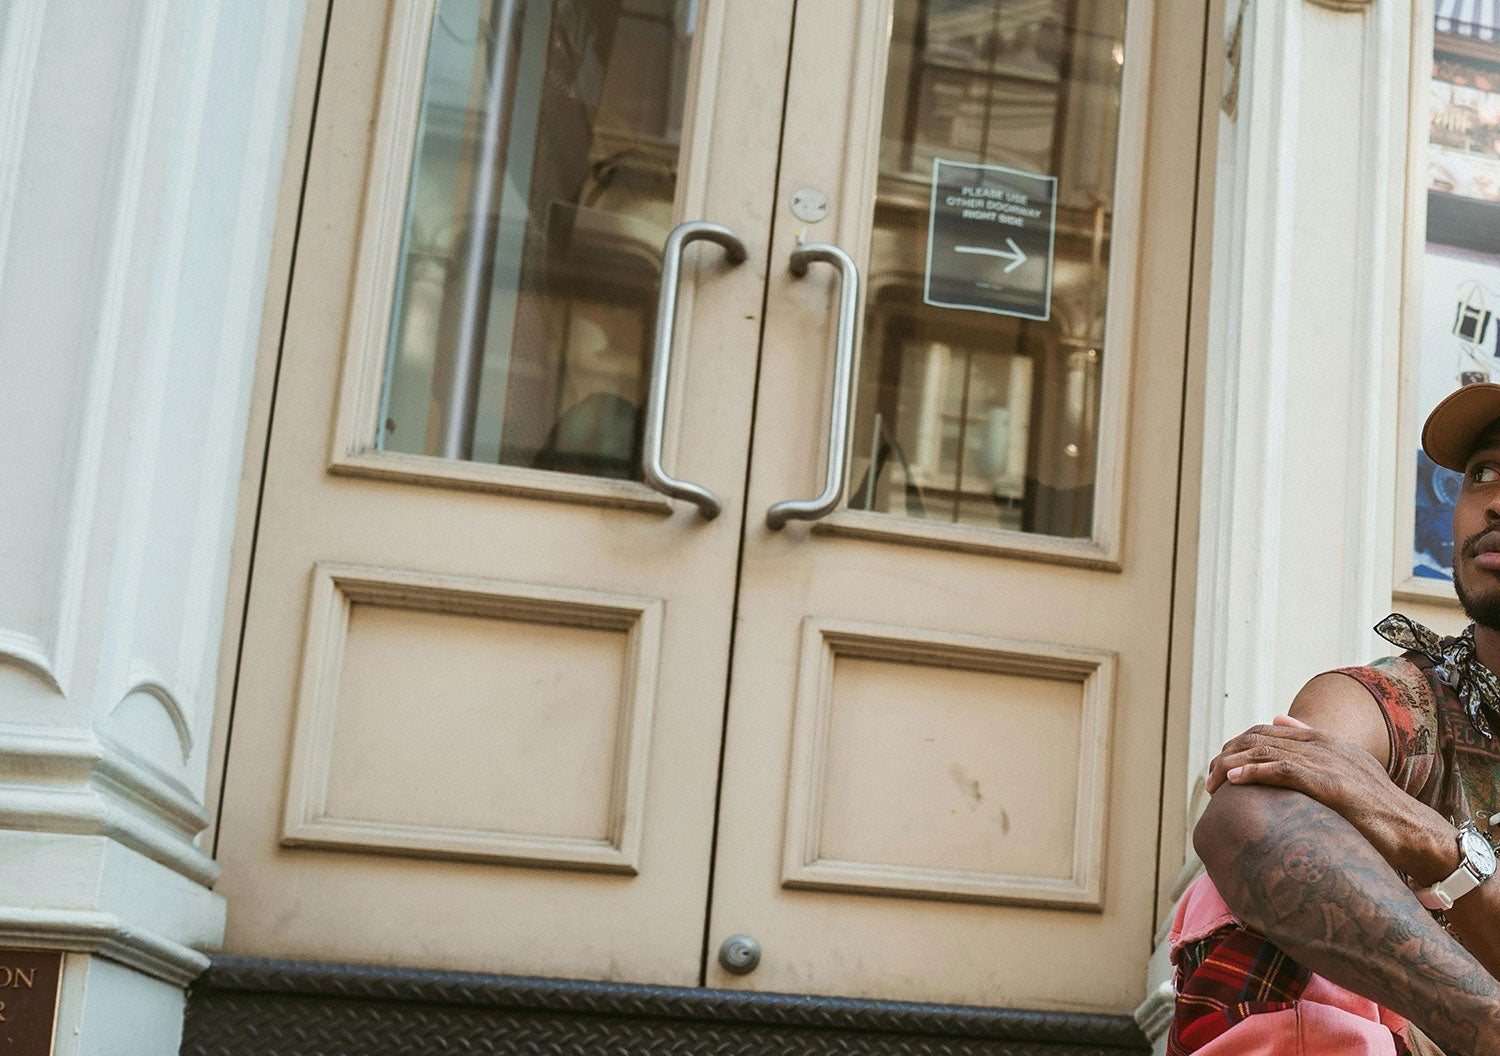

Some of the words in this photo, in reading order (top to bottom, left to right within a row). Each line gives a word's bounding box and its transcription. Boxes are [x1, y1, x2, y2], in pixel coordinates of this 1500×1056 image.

[961, 186, 1004, 200] PLEASE
[1005, 192, 1029, 205] USE
[945, 195, 985, 208] OTHER
[986, 200, 1042, 218] DOORWAY
[962, 208, 997, 220] RIGHT
[999, 213, 1024, 227] SIDE
